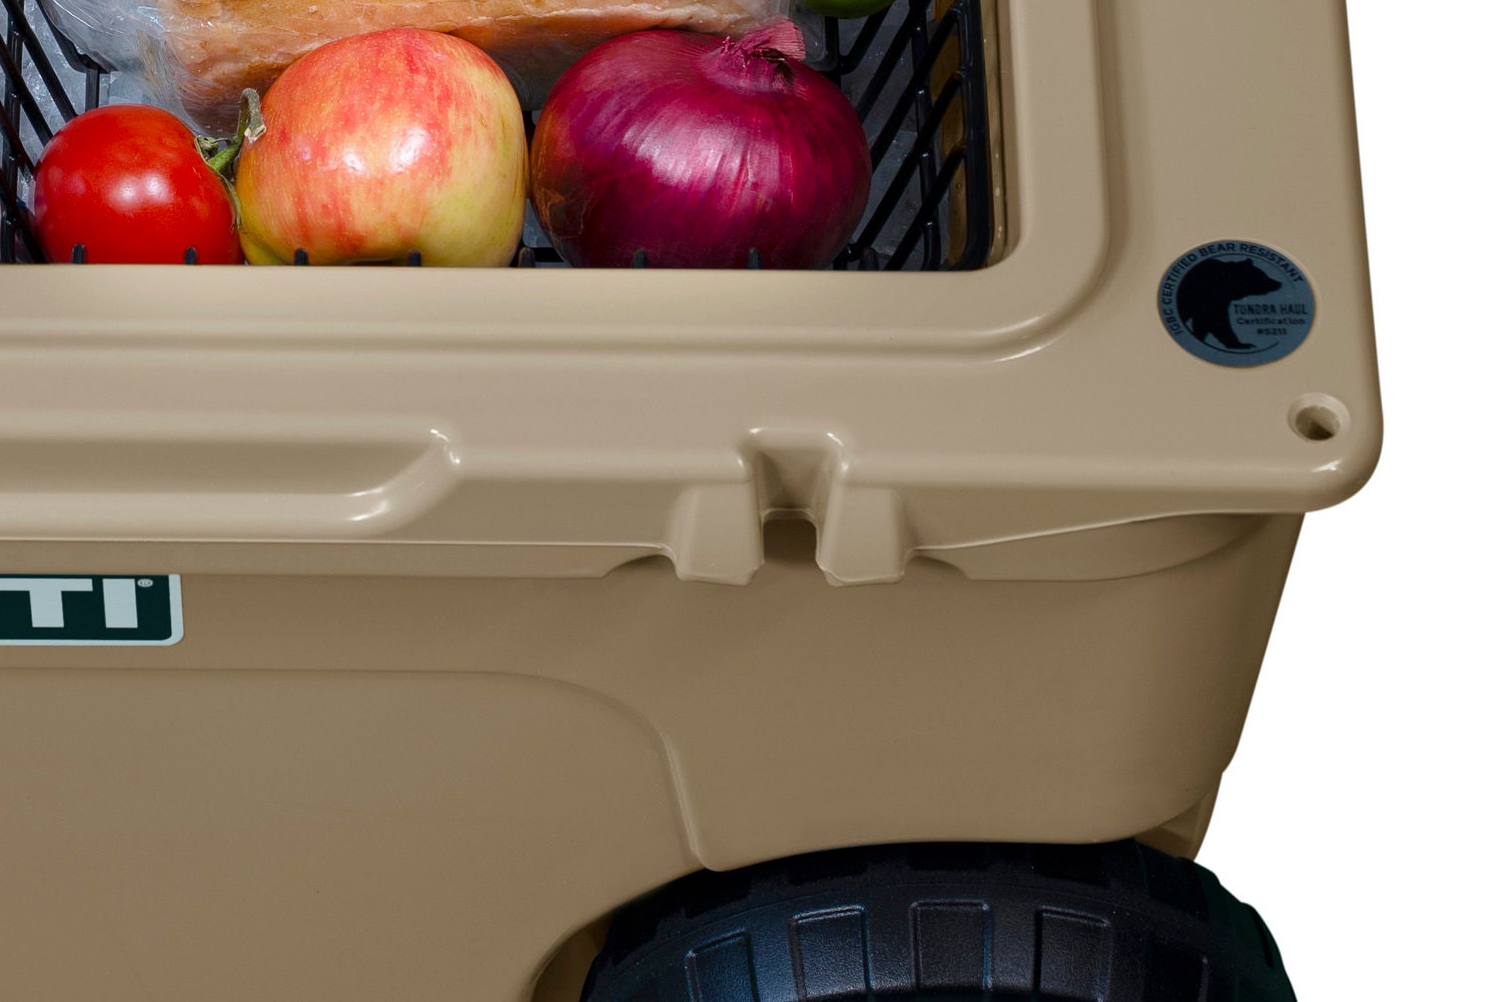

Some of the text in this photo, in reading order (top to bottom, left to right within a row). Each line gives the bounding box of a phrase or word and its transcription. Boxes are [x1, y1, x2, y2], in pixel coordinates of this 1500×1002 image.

[1162, 243, 1303, 336] IGBC CERTIFIED BEAR RESISTANT
[1233, 304, 1308, 315] TUNDRA HAUL
[1236, 318, 1306, 326] Certification
